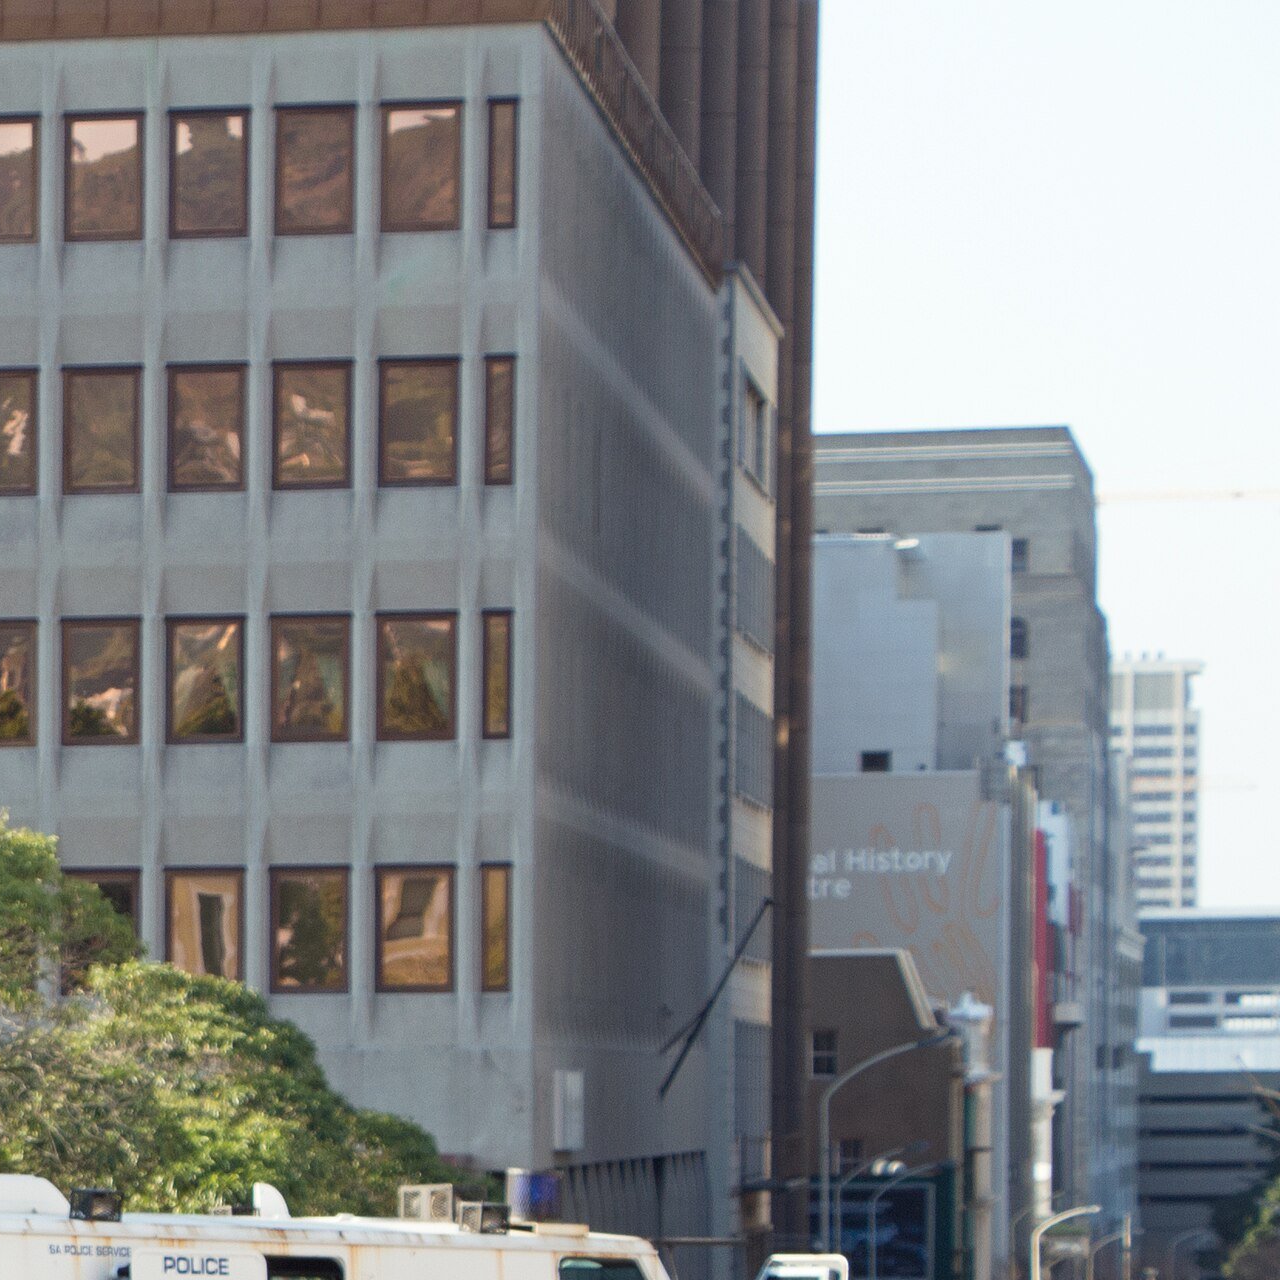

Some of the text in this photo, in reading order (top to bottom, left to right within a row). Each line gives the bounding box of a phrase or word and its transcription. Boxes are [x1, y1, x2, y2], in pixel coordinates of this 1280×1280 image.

[844, 848, 953, 875] History
[64, 1245, 93, 1256] POLICE
[164, 1256, 230, 1276] POLICE
